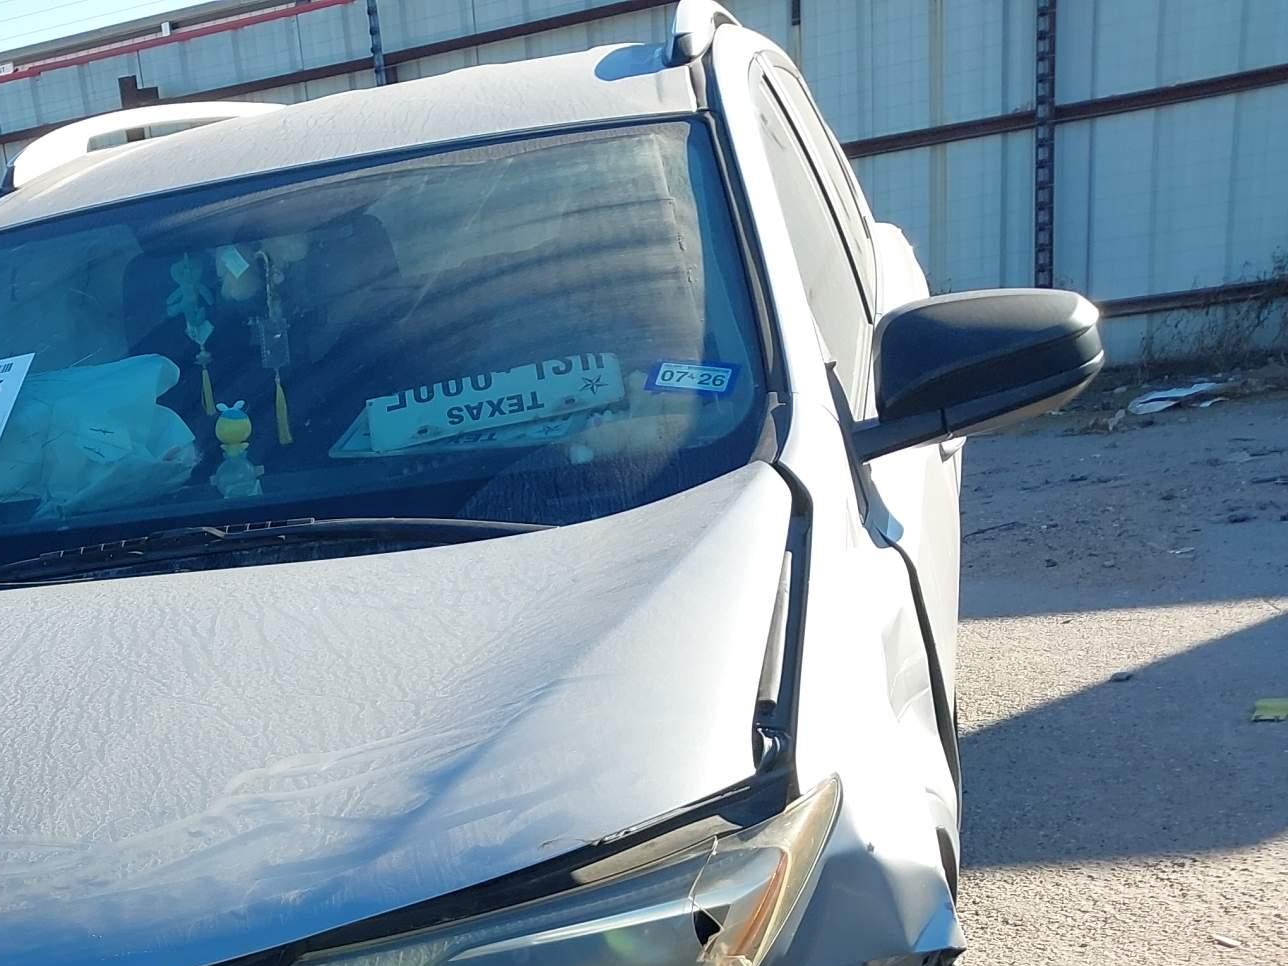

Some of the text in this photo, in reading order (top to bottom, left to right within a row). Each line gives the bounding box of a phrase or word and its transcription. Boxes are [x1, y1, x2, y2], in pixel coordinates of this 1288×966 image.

[661, 369, 726, 387] 07 26
[446, 390, 544, 425] TEXAS
